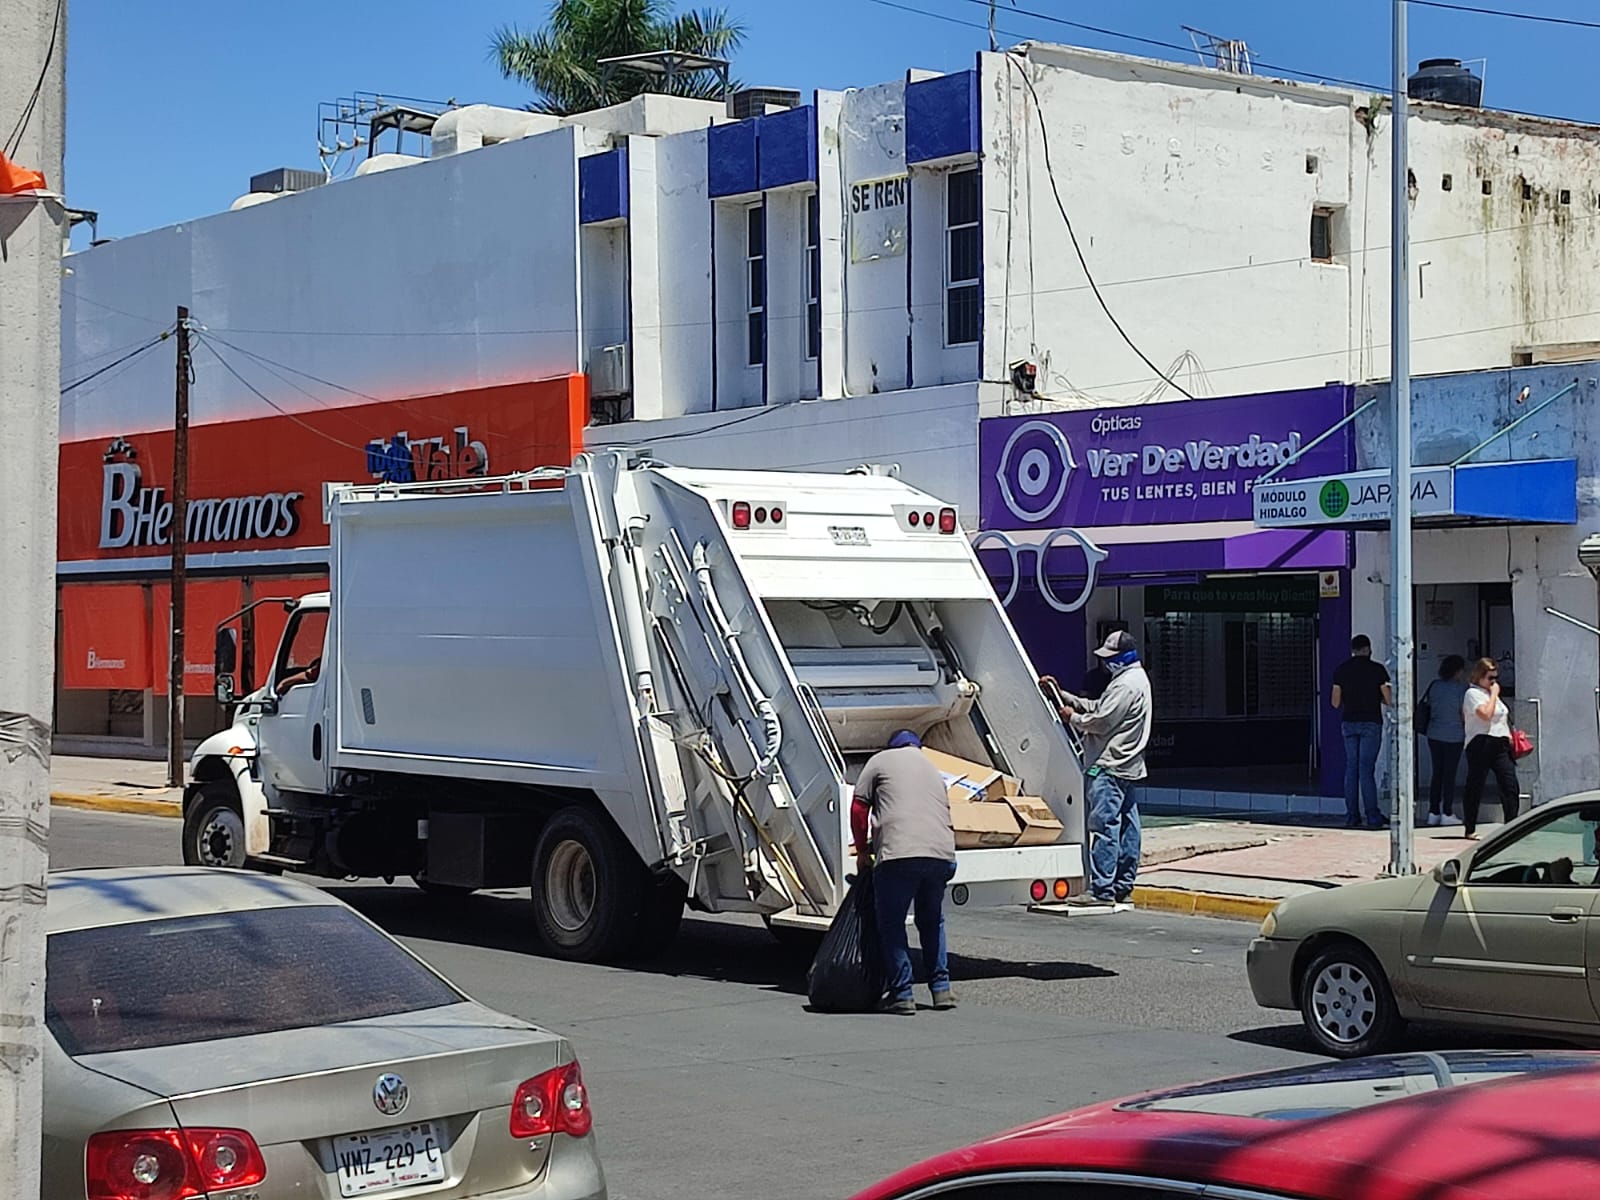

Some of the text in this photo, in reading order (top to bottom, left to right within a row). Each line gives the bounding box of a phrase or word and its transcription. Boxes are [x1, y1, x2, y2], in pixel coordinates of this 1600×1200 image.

[852, 177, 909, 214] SE REN
[1091, 414, 1142, 436] Ópticas
[409, 427, 489, 481] Vale
[1087, 448, 1138, 478] Ver
[1102, 486, 1130, 501] TUS
[1136, 482, 1198, 501] LENTES,
[1201, 480, 1236, 496] BIEN
[1260, 487, 1307, 504] MÓDULO
[1350, 480, 1438, 507] JAPMA
[99, 462, 304, 549] BHemanos
[1259, 506, 1307, 520] HIDALGO
[1163, 588, 1191, 601] Para
